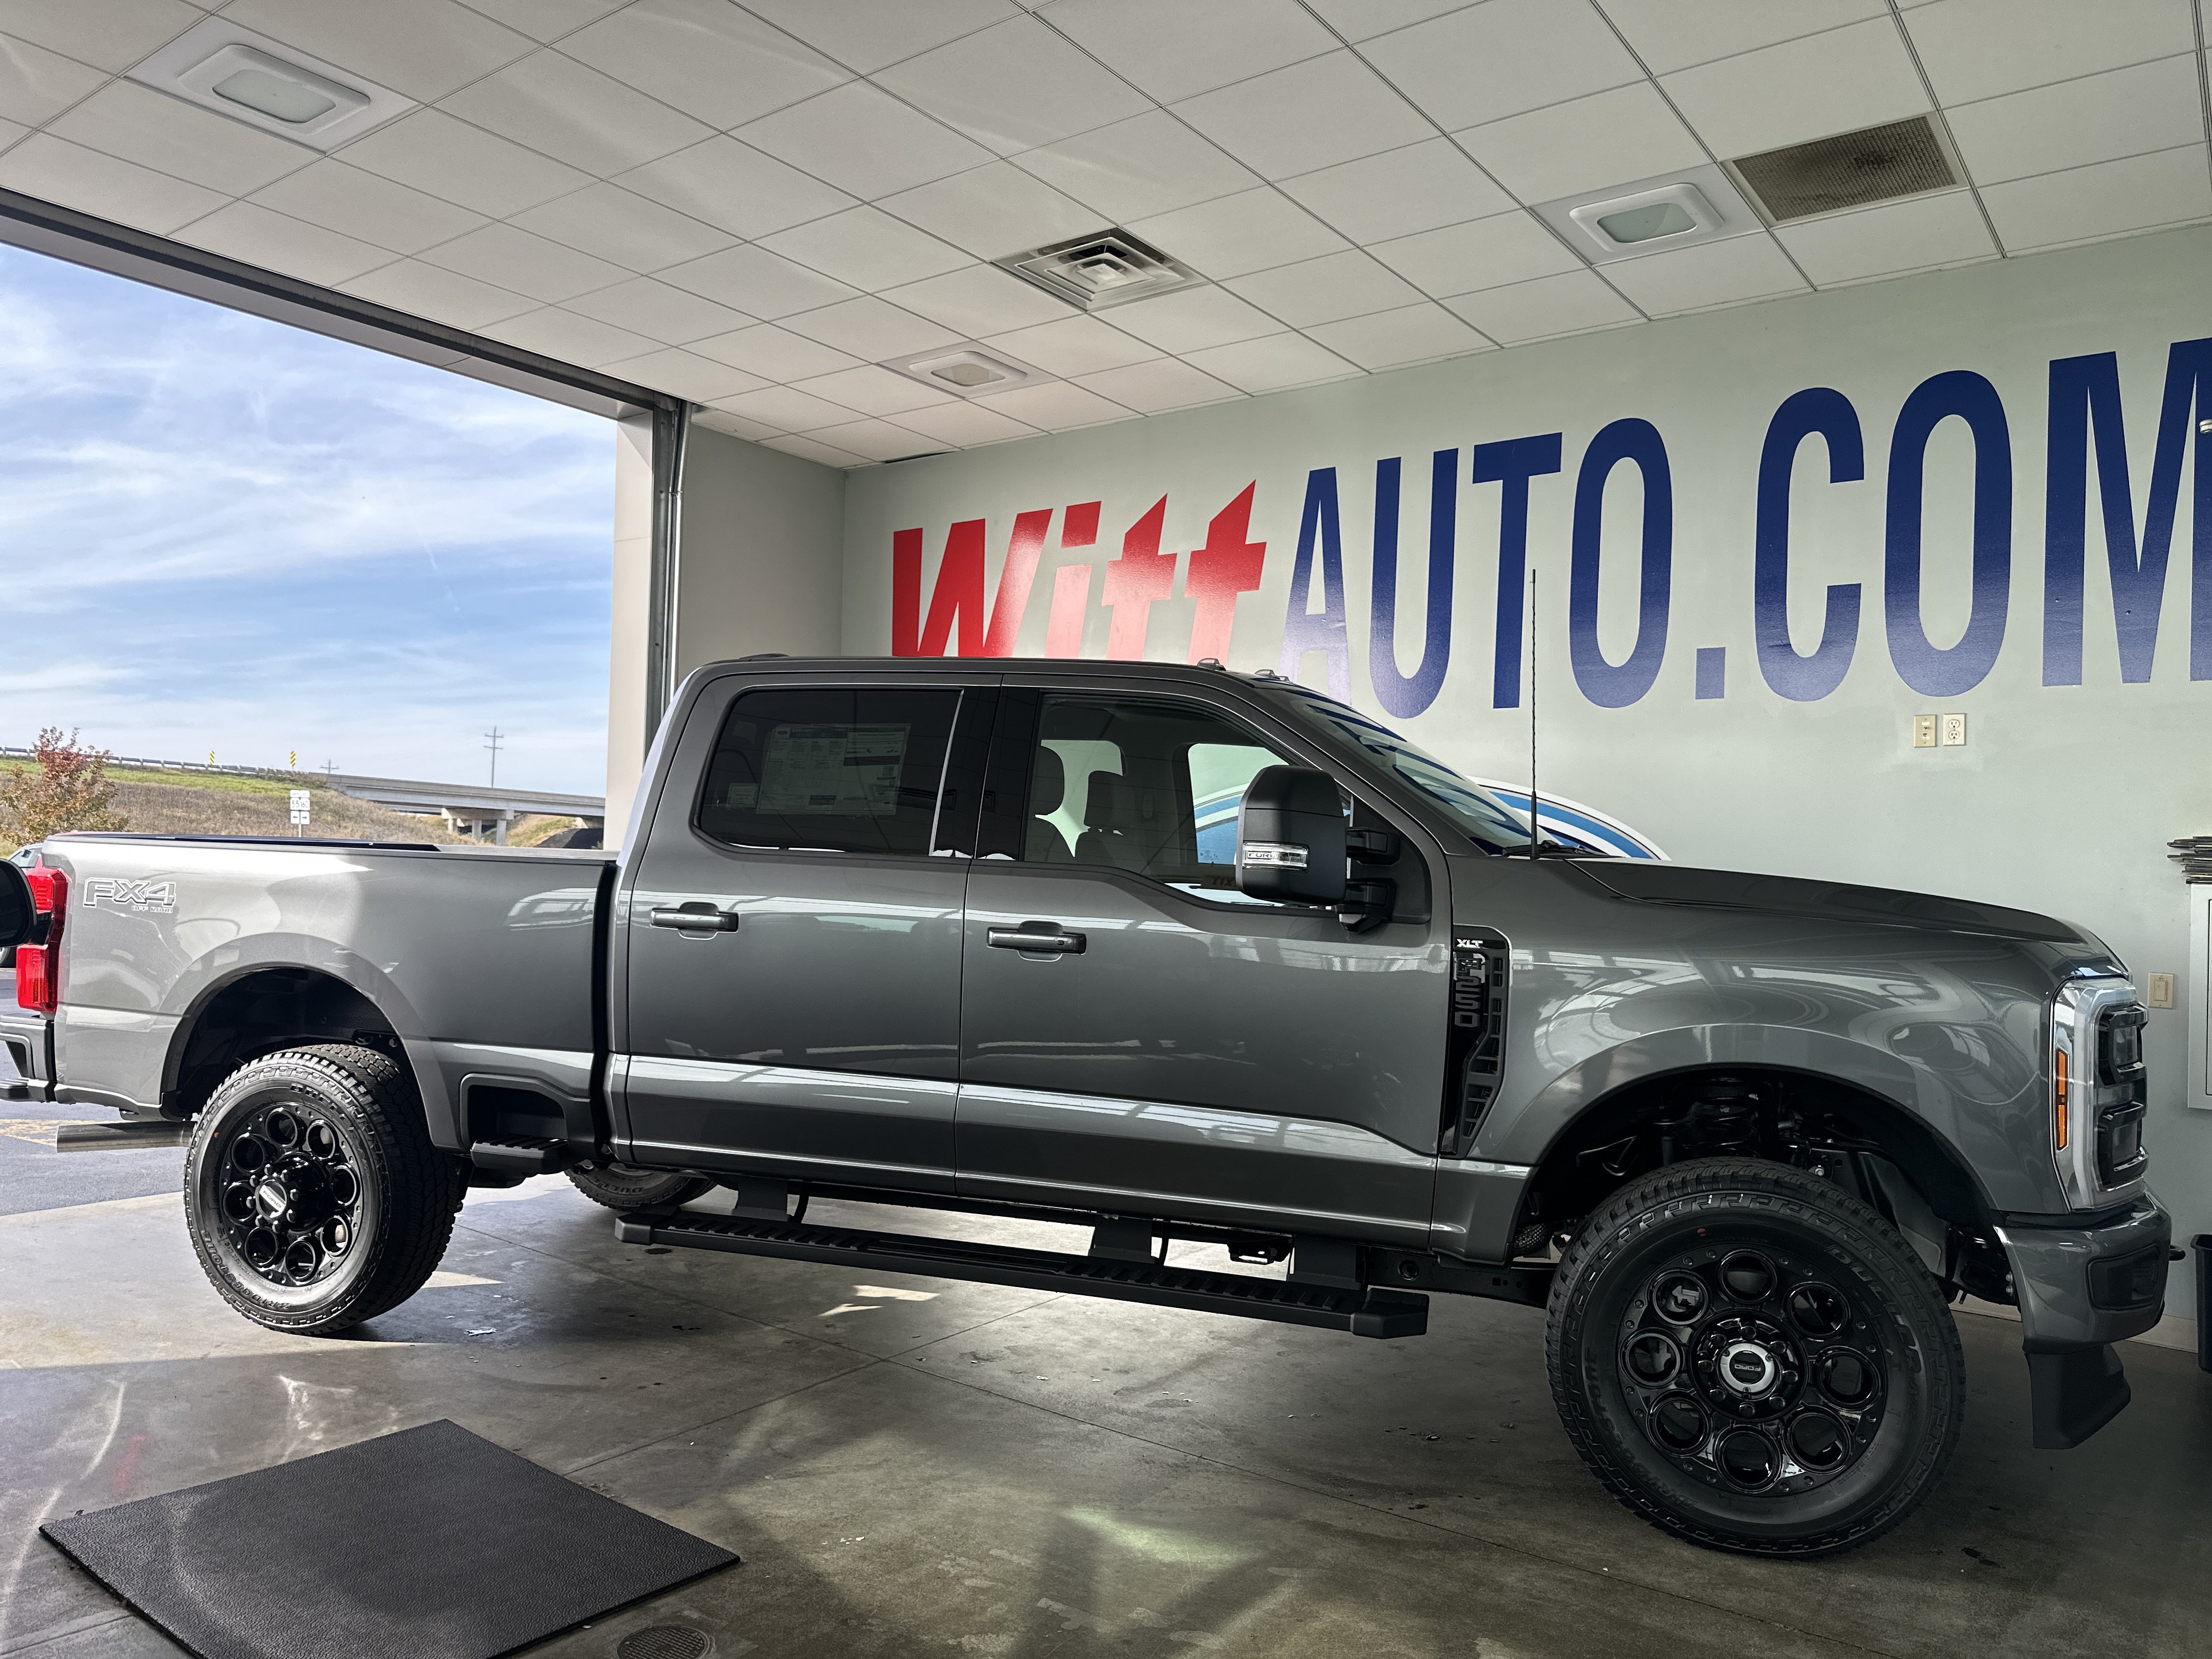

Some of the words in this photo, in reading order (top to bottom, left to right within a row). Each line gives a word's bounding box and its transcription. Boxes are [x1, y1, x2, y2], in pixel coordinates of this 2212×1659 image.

[83, 877, 176, 907] FX4
[1457, 939, 1483, 949] XLT
[263, 1190, 281, 1208] FORD
[201, 1230, 291, 1310] BRIDGESTONE
